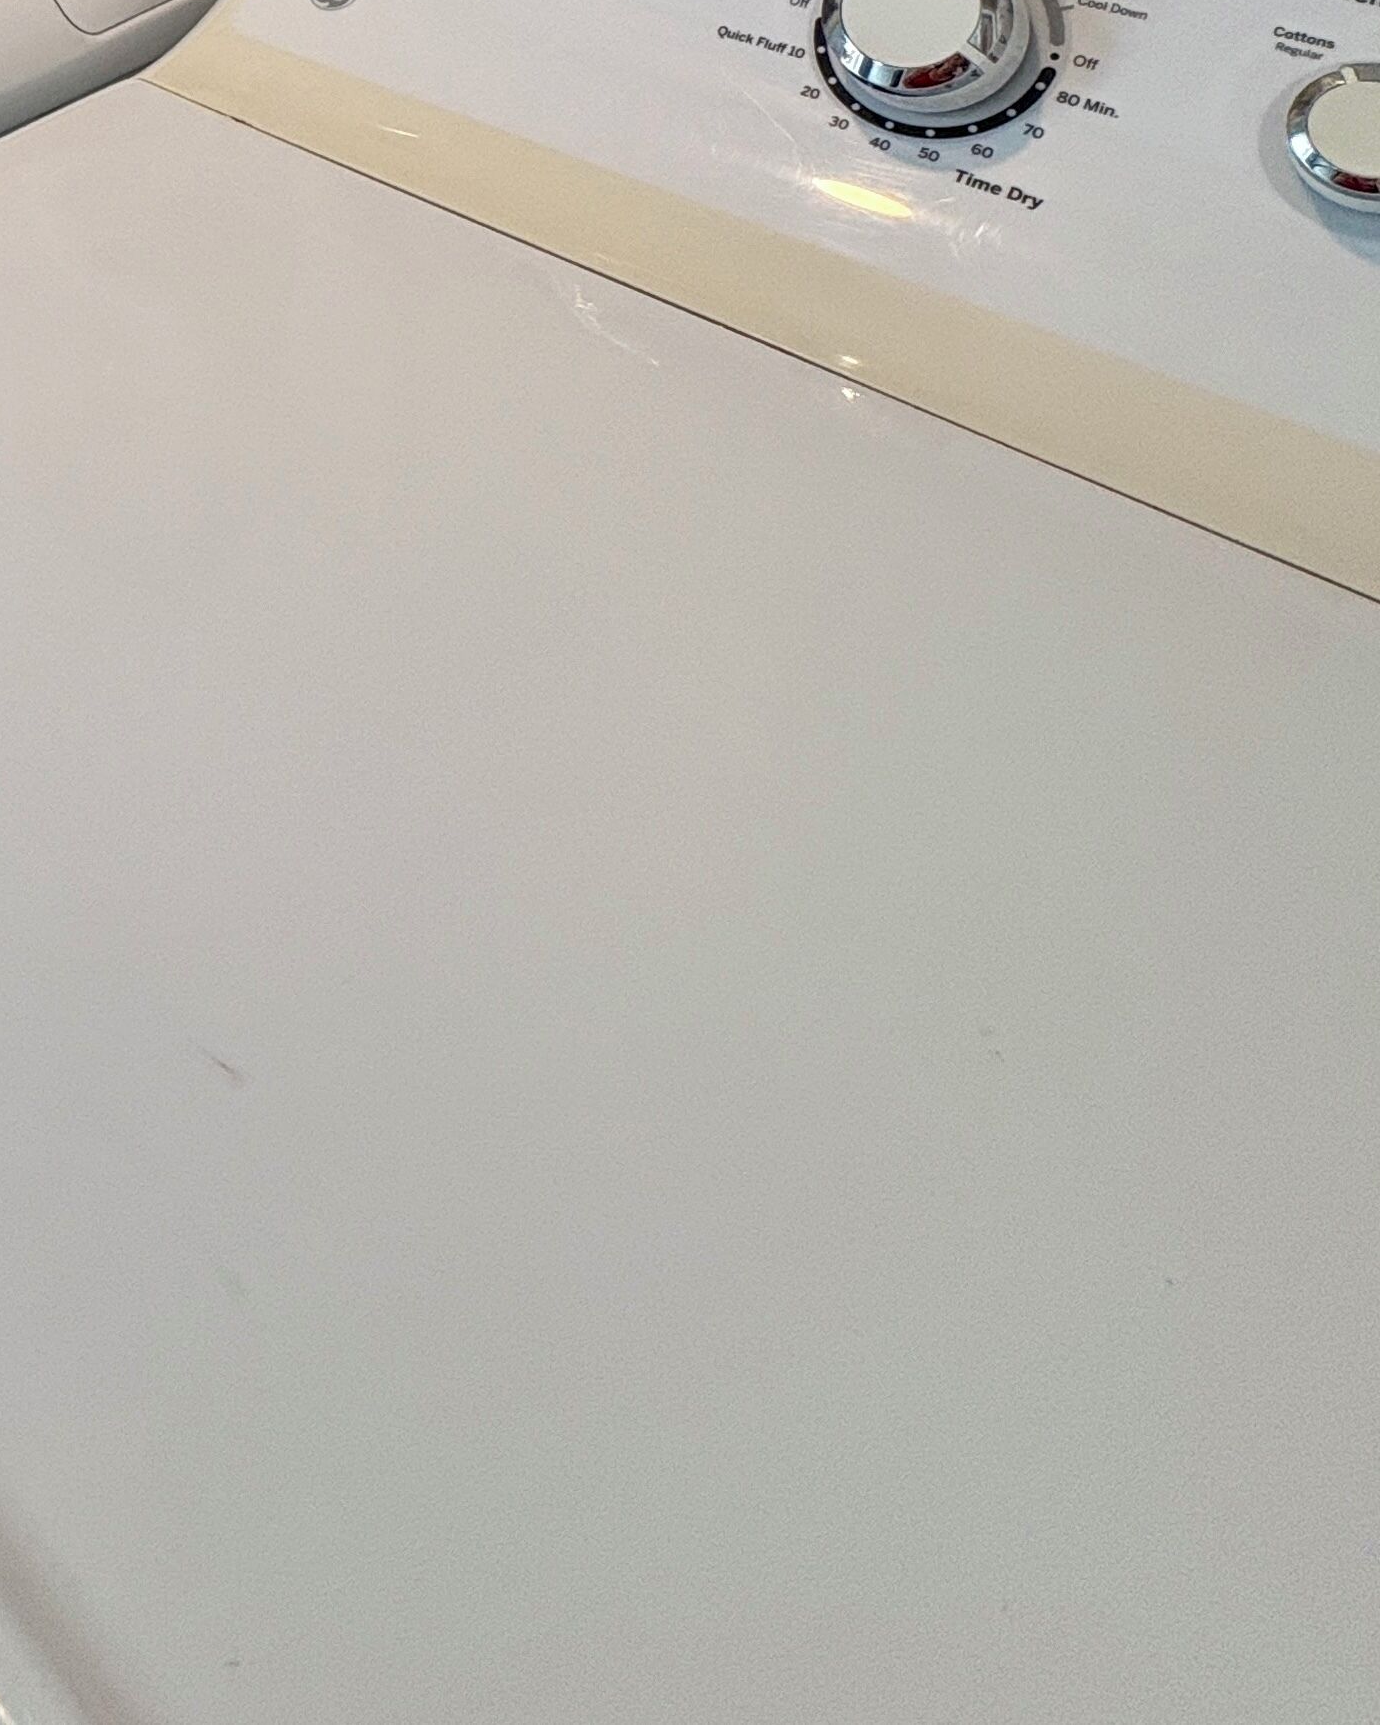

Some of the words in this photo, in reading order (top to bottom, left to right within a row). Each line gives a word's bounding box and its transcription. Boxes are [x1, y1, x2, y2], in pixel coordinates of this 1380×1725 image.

[1110, 3, 1149, 21] Down
[717, 25, 753, 46] Quick
[755, 37, 787, 55] Fluff
[788, 45, 806, 59] 10
[1273, 26, 1336, 50] Cottons
[1275, 41, 1325, 61] Regular
[1073, 55, 1101, 71] Off
[800, 85, 821, 100] 20
[1056, 91, 1081, 107] 80
[1082, 97, 1121, 119] Min.
[828, 115, 850, 131] 30
[1022, 123, 1046, 140] 70
[868, 137, 892, 152] 40
[970, 143, 995, 159] 60
[917, 147, 941, 163] 50
[955, 169, 1003, 196] Time
[1006, 186, 1045, 211] Dry
